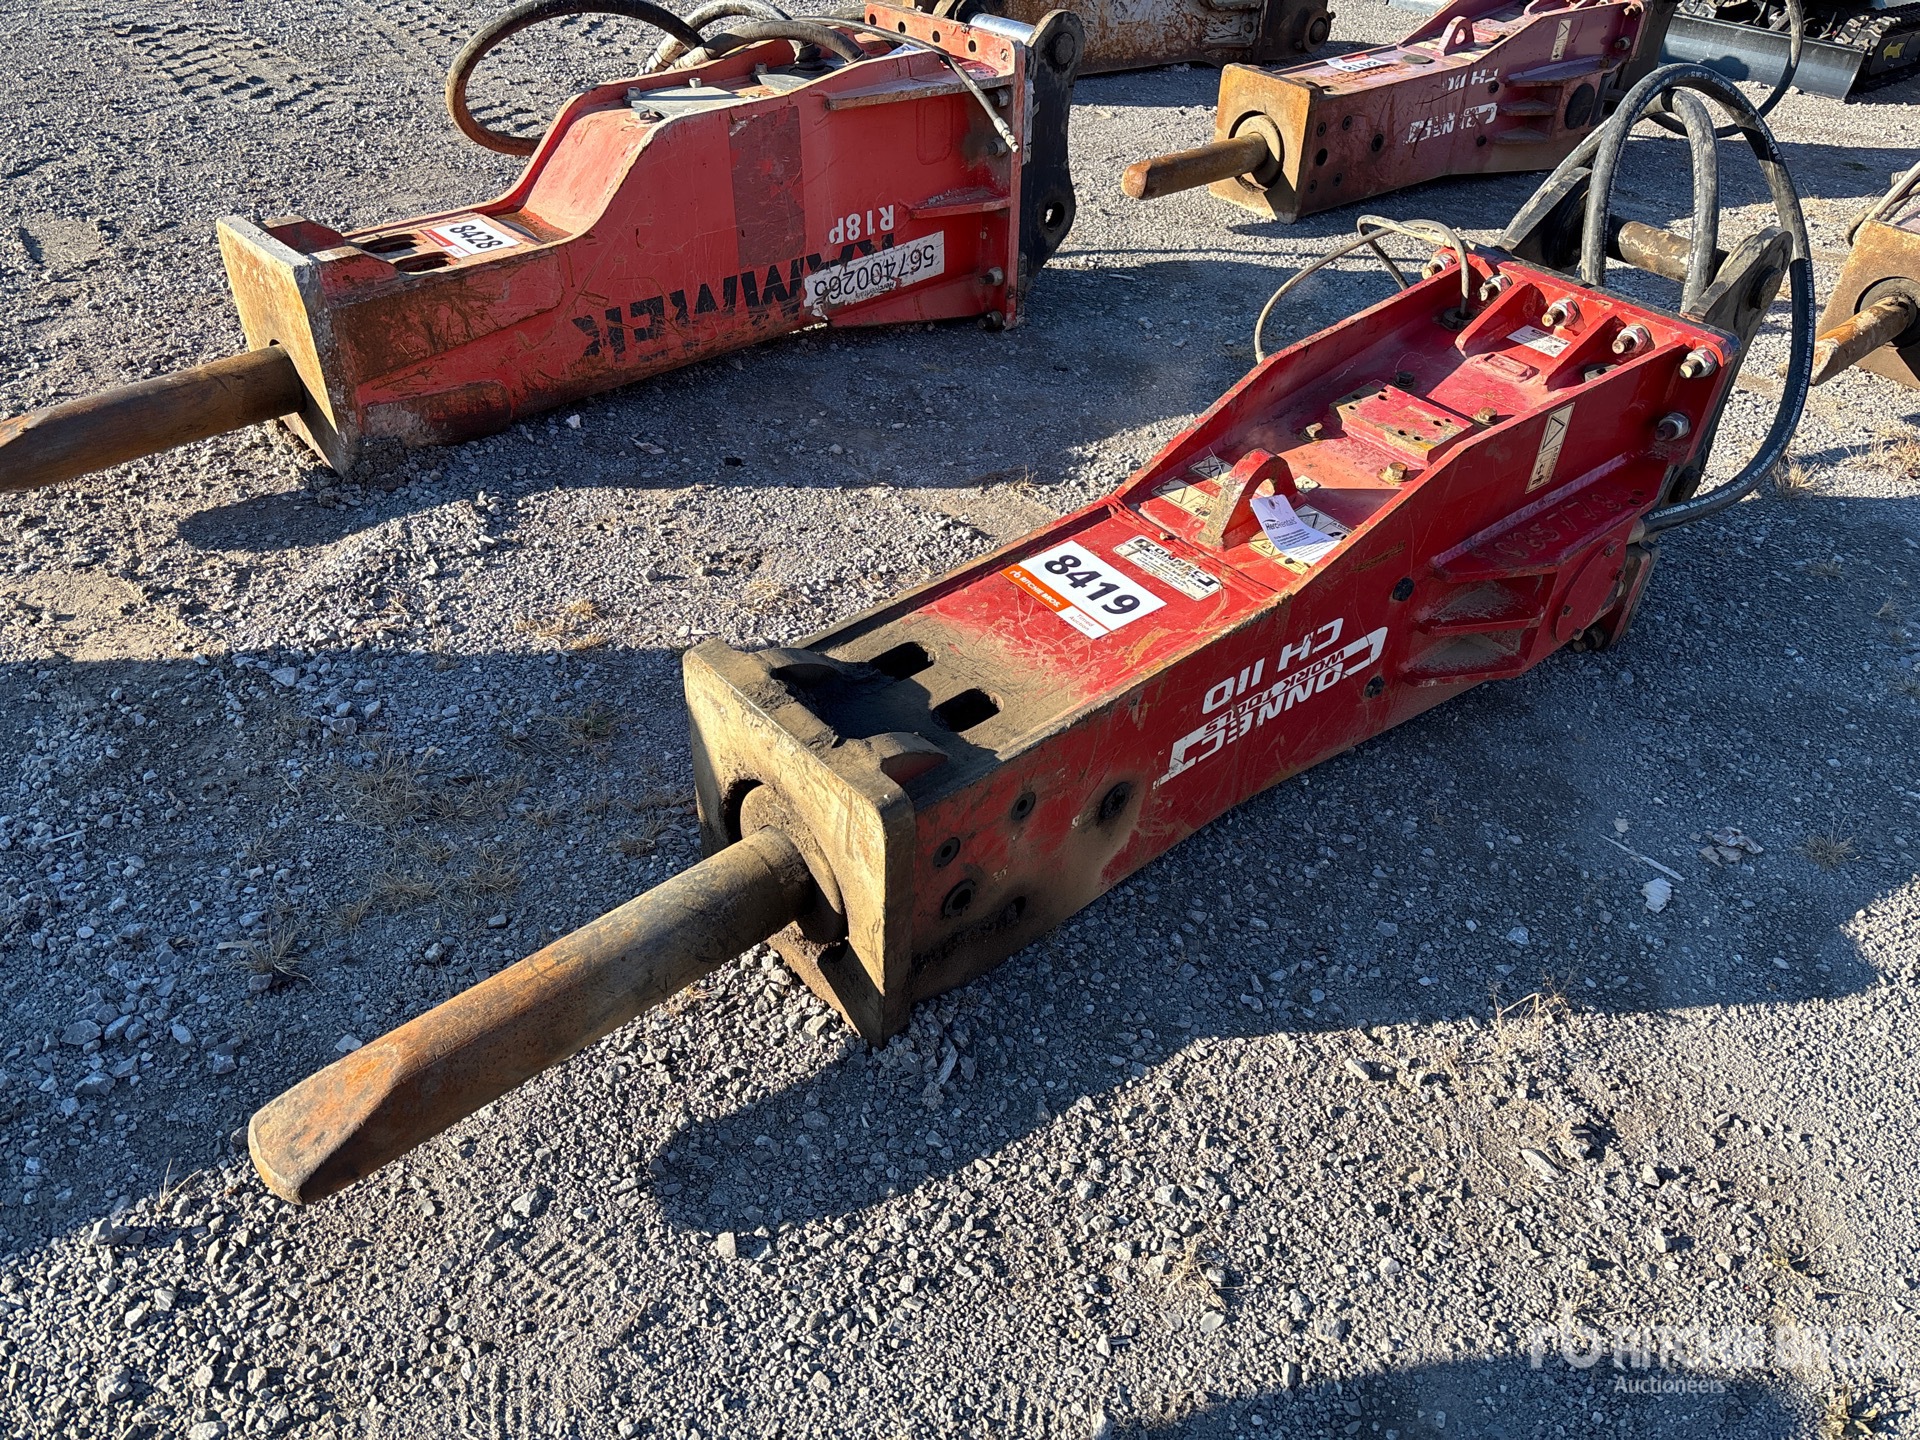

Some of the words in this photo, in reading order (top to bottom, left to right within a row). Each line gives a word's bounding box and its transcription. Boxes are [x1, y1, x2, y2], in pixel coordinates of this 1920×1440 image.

[449, 225, 503, 249] 8428
[828, 204, 894, 244] R18P
[1019, 576, 1045, 598] RITCHIE
[1044, 555, 1141, 615] 8419
[1187, 579, 1209, 593] PARTS
[1069, 615, 1090, 631] Auction
[1076, 613, 1094, 627] Timed
[1277, 617, 1344, 672] CH
[1283, 650, 1346, 689] WORK
[1152, 626, 1388, 790] CONNECT
